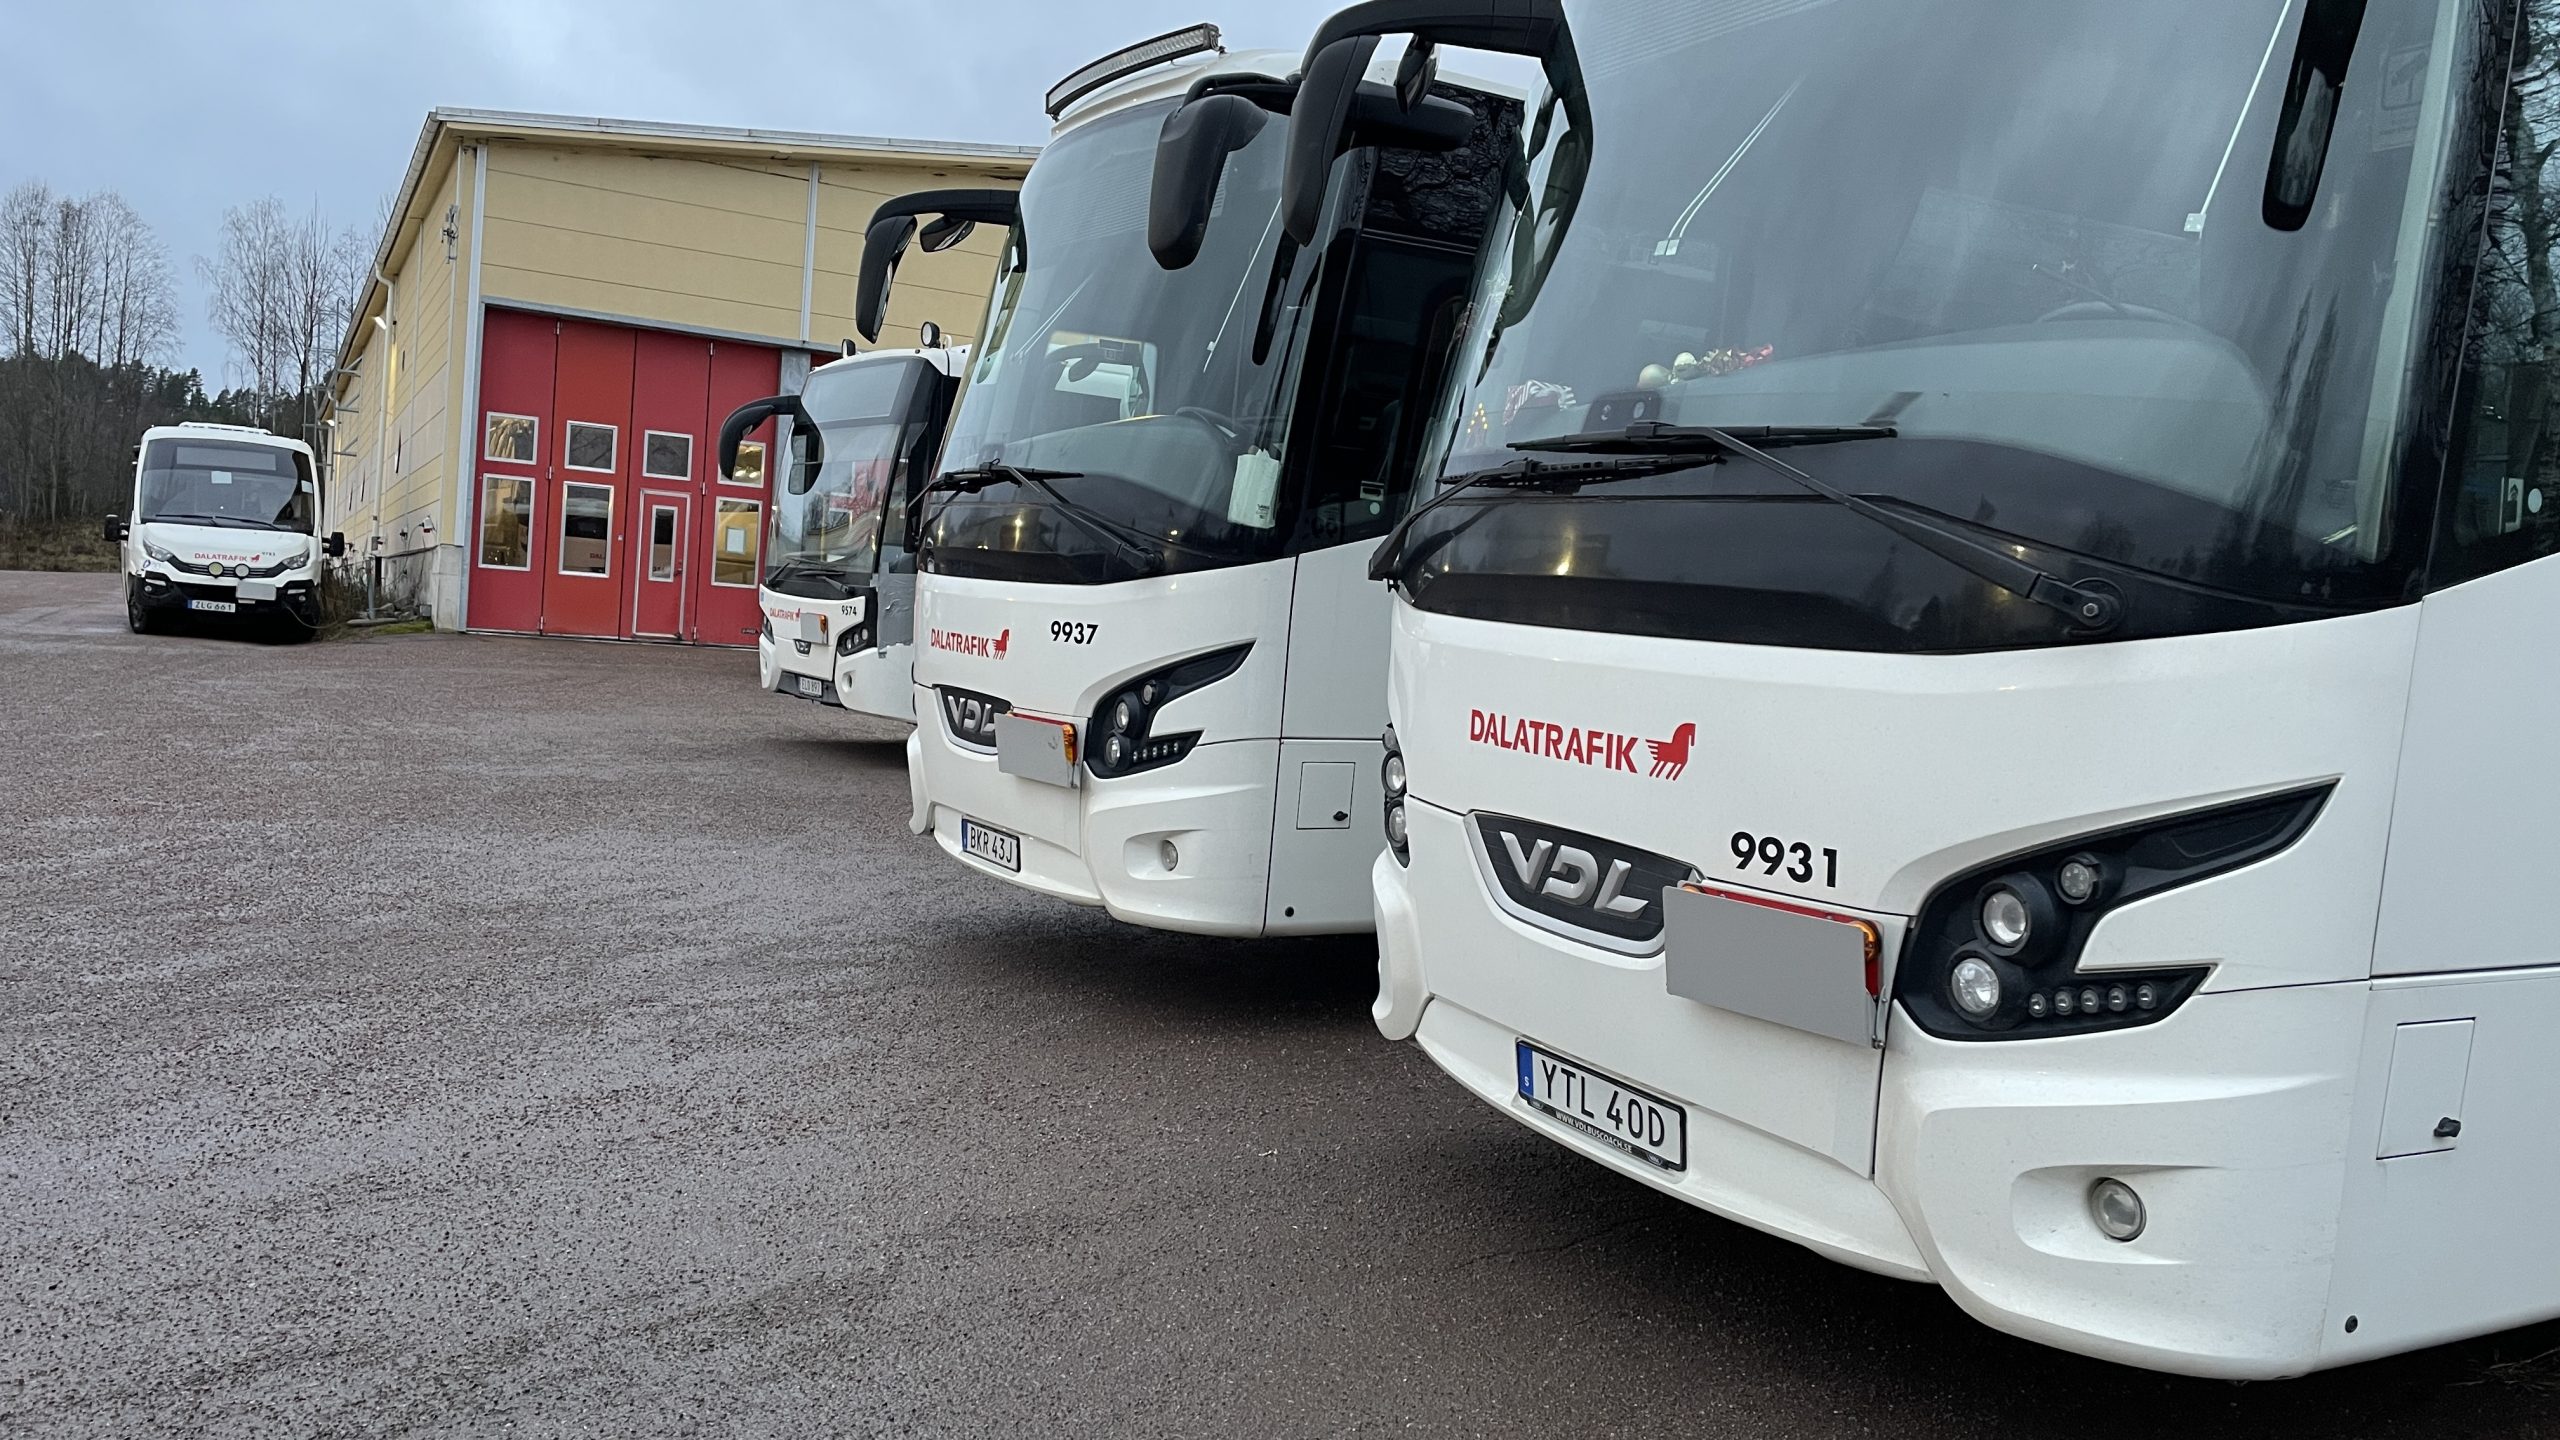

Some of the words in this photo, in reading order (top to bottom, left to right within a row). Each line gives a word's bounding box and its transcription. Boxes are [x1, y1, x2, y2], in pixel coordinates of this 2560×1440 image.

[194, 552, 247, 562] DALATRAFIK
[195, 601, 212, 609] ZLG
[214, 603, 231, 611] 661
[841, 605, 857, 616] 9574
[931, 628, 990, 658] DALATRAFIK
[1050, 620, 1099, 645] 9937
[947, 695, 996, 737] VDL
[1470, 708, 1639, 775] DALATRAFIK
[970, 826, 989, 855] BKR
[992, 835, 1012, 864] 43J
[1730, 831, 1838, 889] 9931
[1499, 830, 1649, 920] VDL
[1524, 1076, 1530, 1087] S
[1541, 1059, 1595, 1119] YTL
[1606, 1090, 1665, 1148] 40D
[1555, 1110, 1633, 1154] WWW.VDLBUSCOACH.SE
